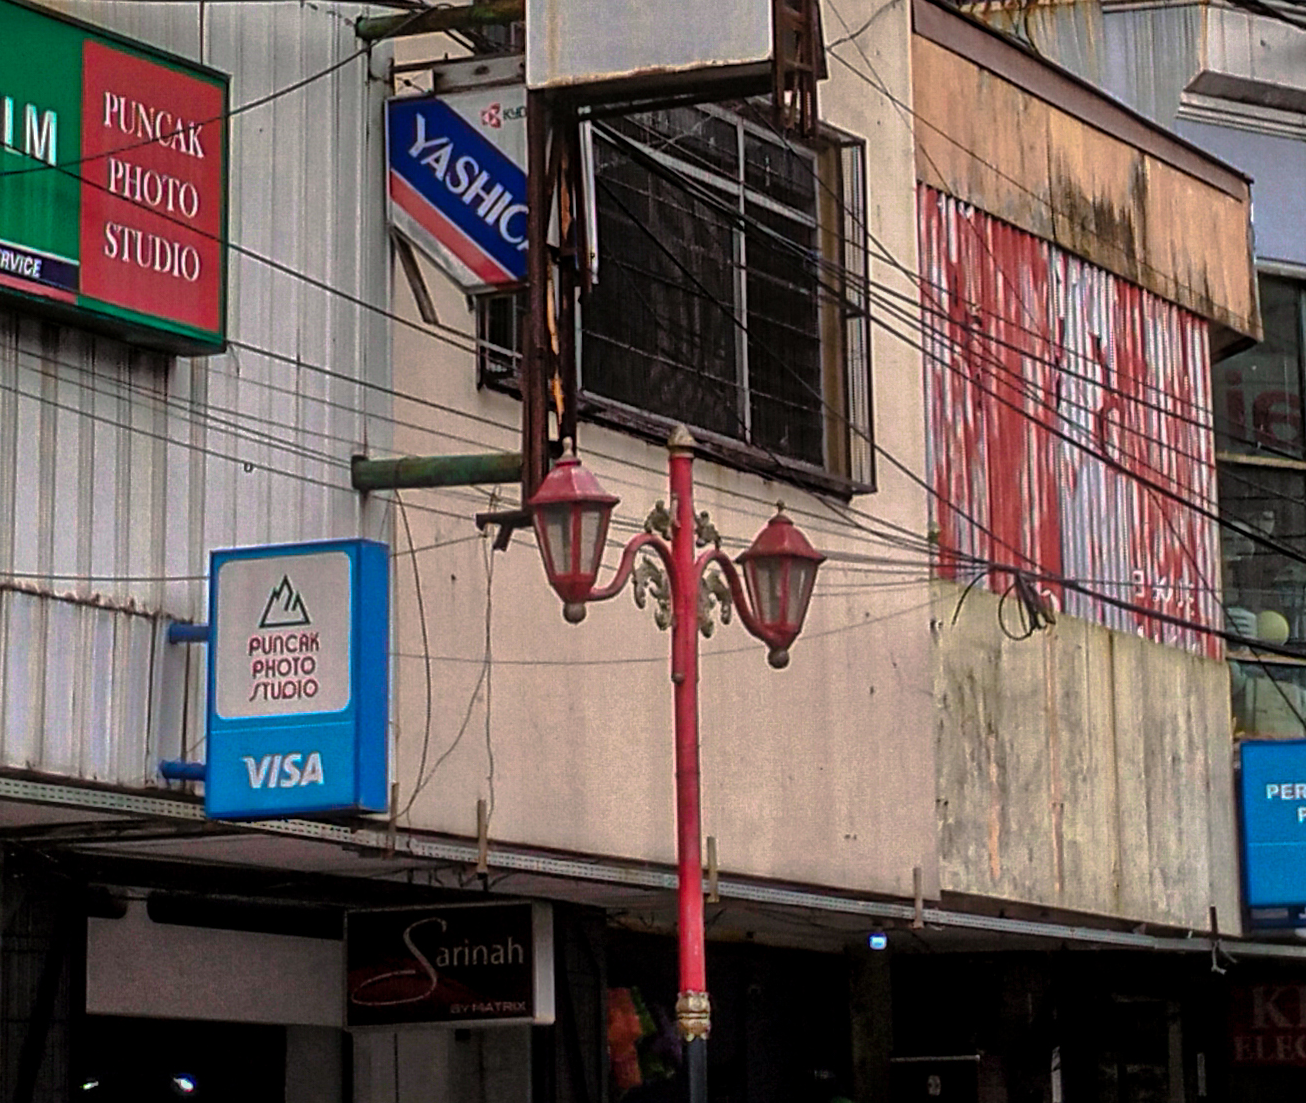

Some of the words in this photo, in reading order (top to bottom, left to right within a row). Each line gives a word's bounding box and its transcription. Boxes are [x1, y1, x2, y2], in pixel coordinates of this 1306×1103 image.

[104, 91, 204, 158] PUNCAK
[108, 157, 199, 219] PHOTO
[409, 112, 530, 252] YASHIC
[104, 221, 200, 282] STUDIO
[248, 632, 320, 657] PUNCAK
[252, 656, 316, 679] PHOTO
[249, 679, 318, 702] STUDIO
[241, 751, 325, 789] VISA
[351, 917, 524, 1006] Sarinah
[471, 1000, 526, 1013] MATRIX
